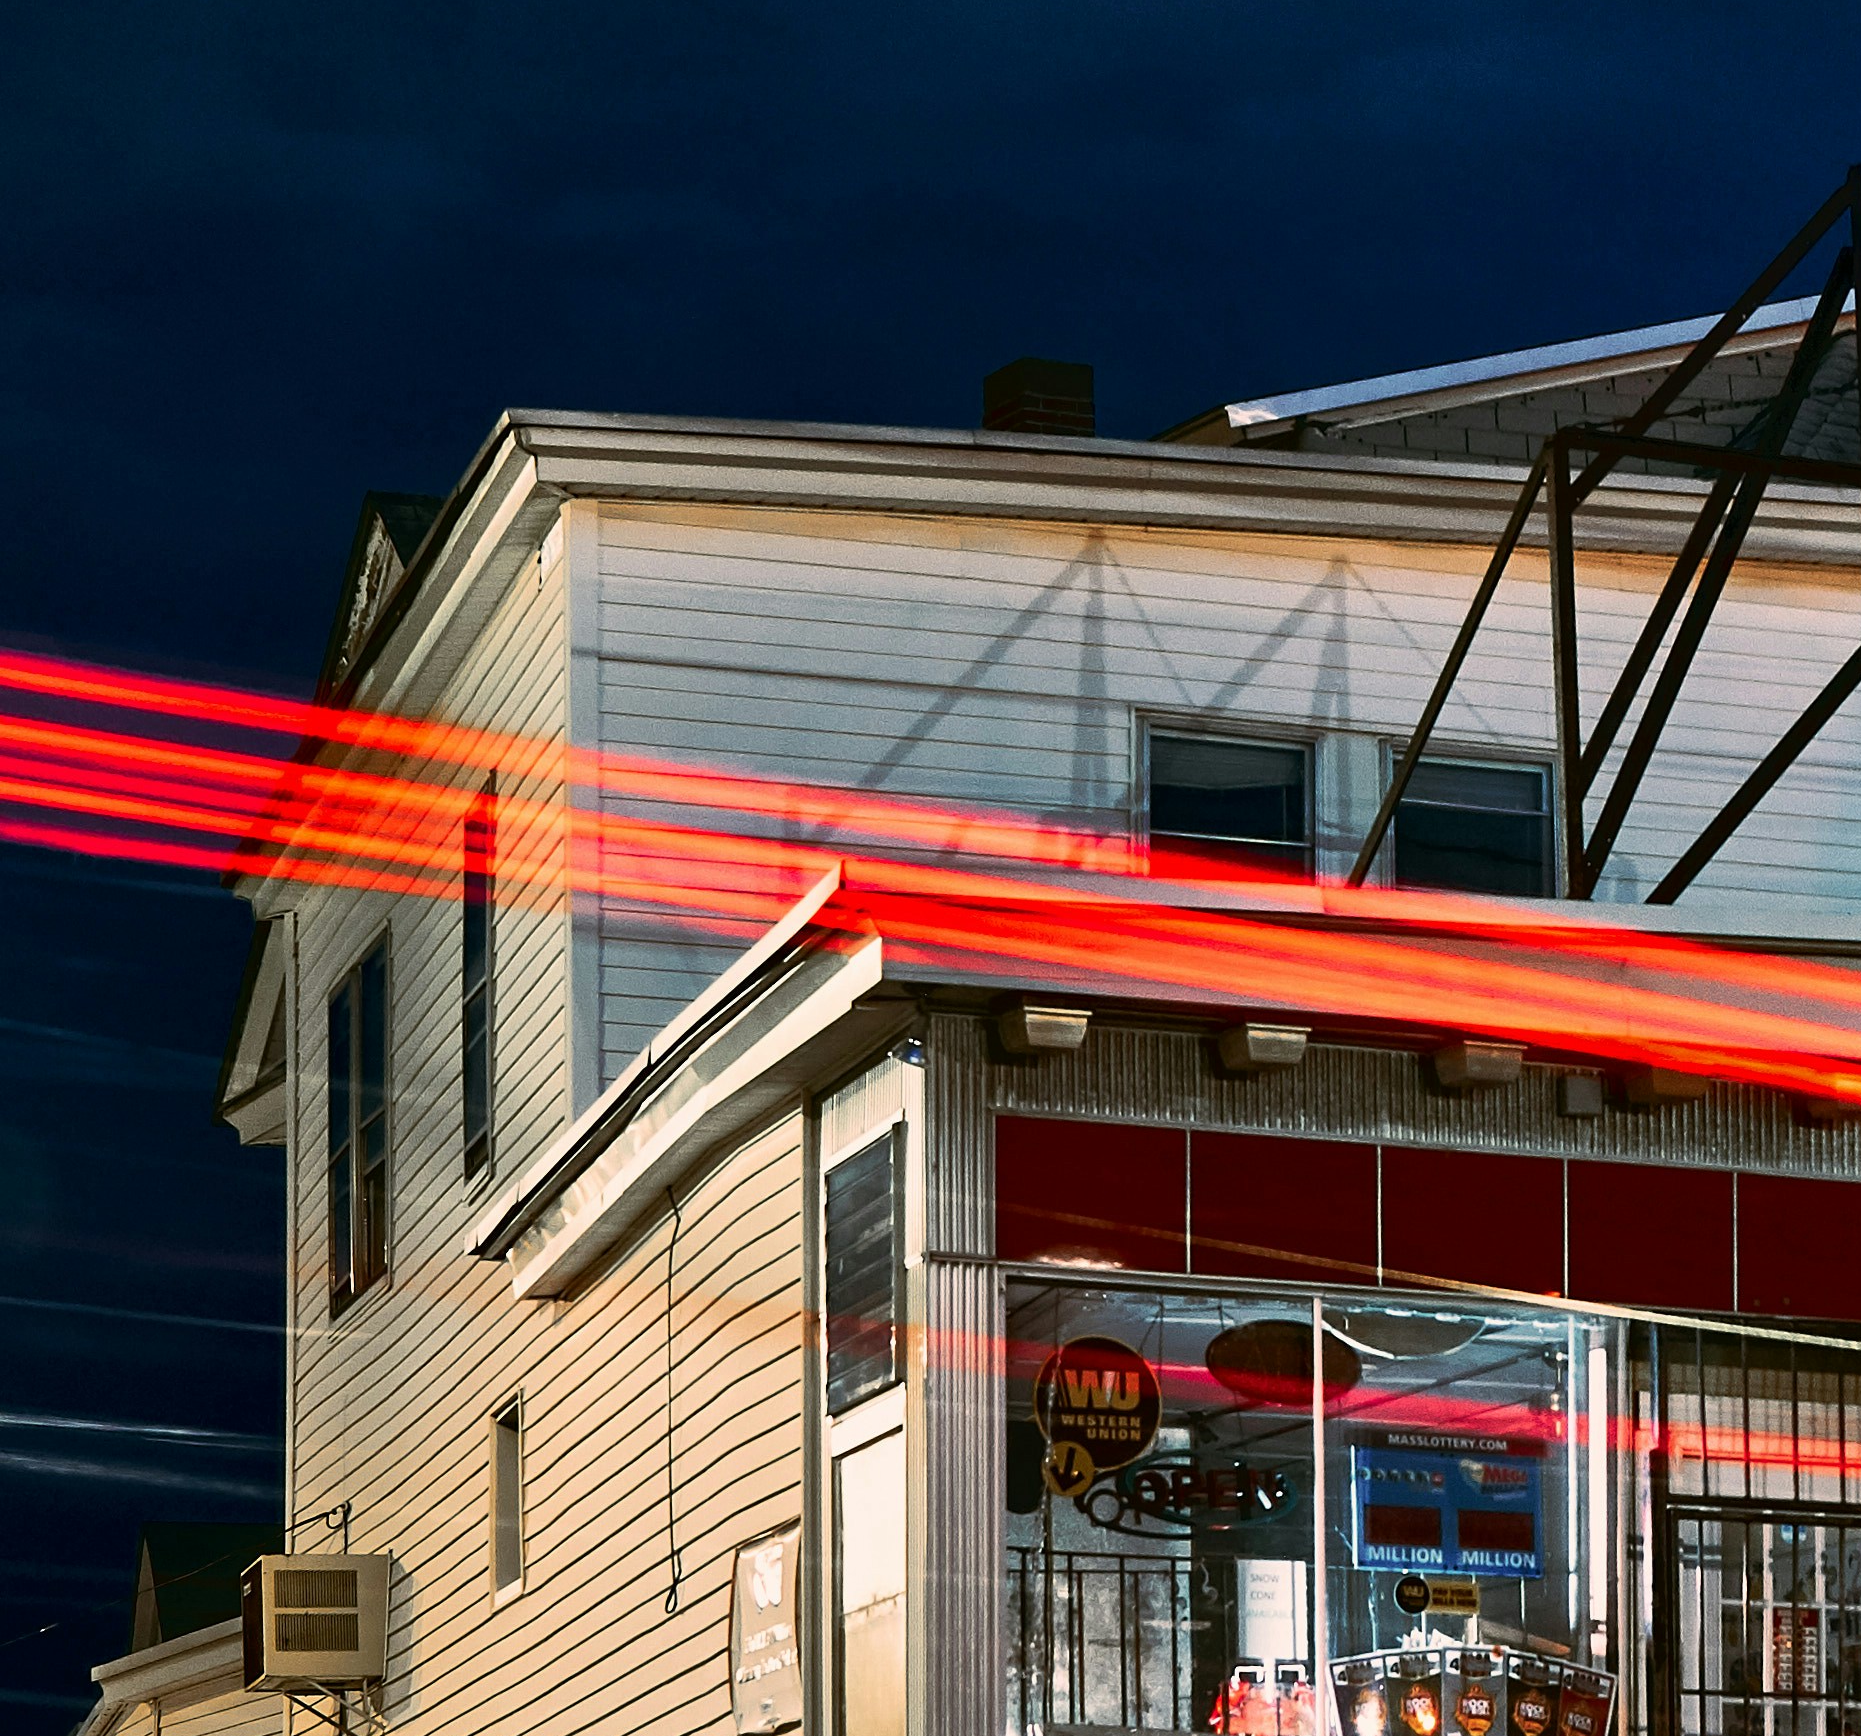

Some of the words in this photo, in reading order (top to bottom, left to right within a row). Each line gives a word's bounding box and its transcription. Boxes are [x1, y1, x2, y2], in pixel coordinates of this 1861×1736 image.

[1062, 1369, 1141, 1411] WU
[1061, 1414, 1142, 1429] WESTERN
[1086, 1428, 1142, 1441] UNION
[1388, 1433, 1508, 1452] MASSLOTTERY.COM
[1132, 1468, 1282, 1512] OPEN
[1367, 1546, 1443, 1564] MILLION
[1461, 1550, 1536, 1569] MILLION
